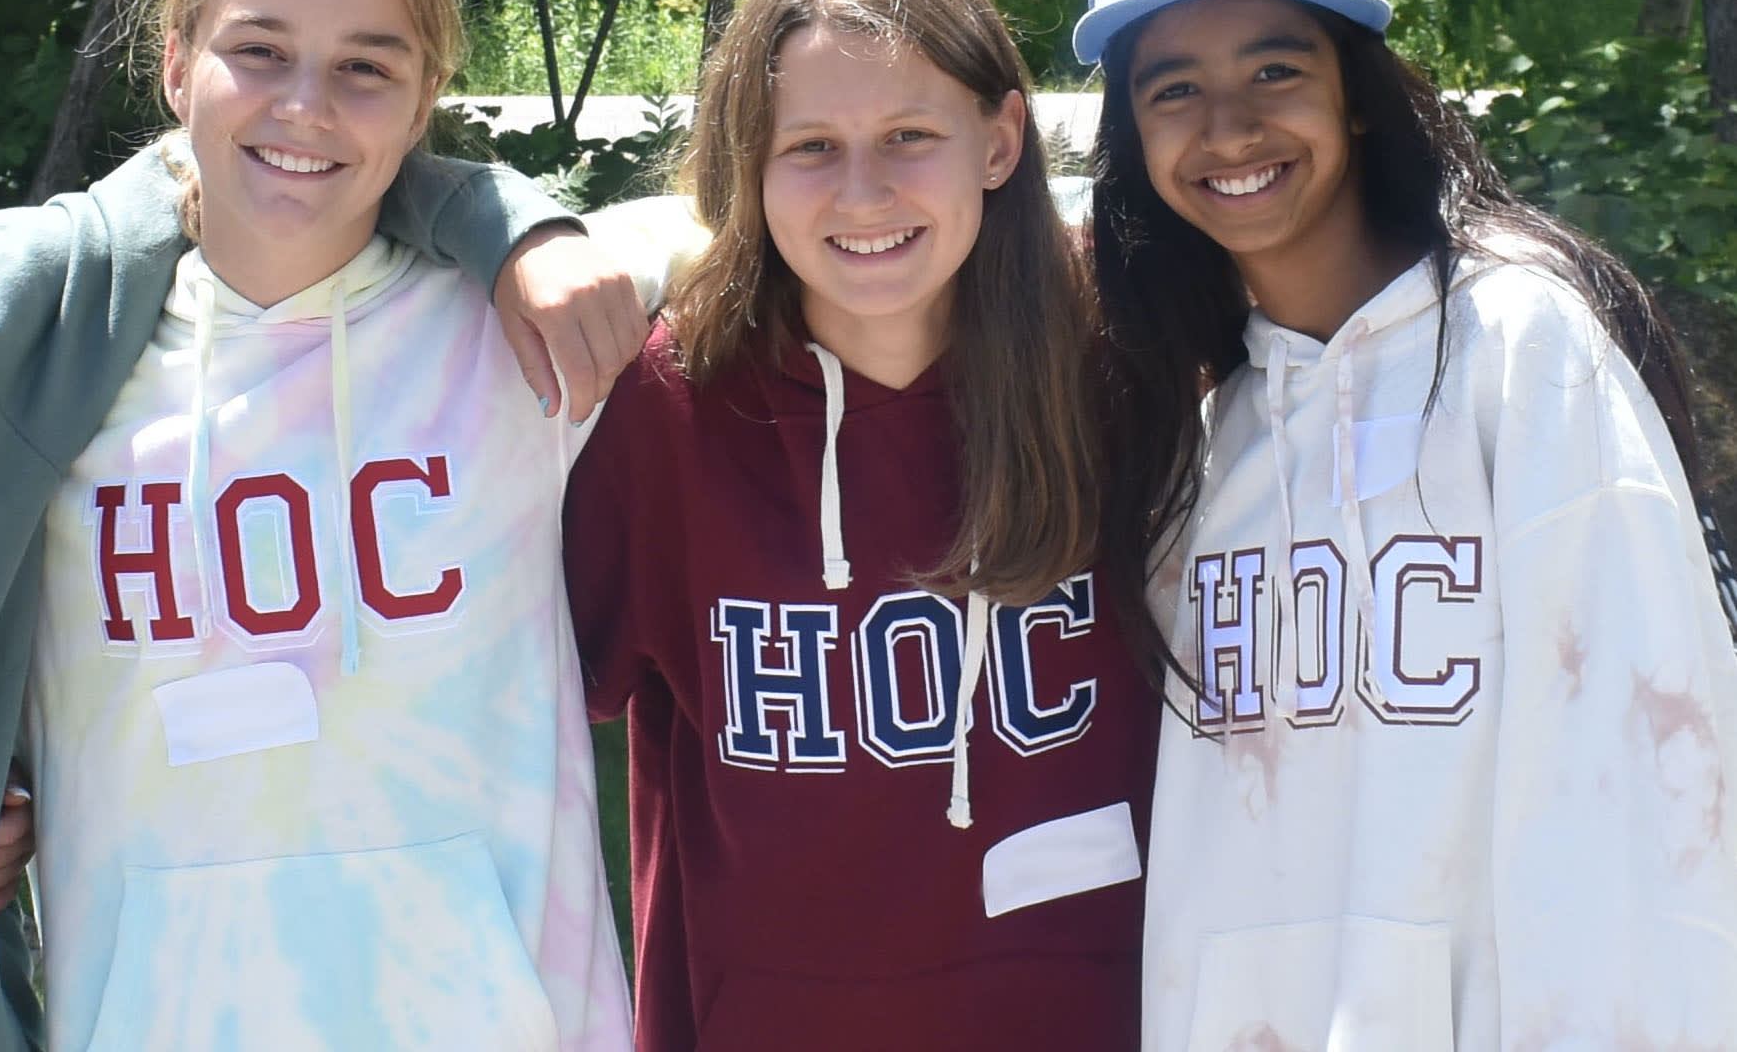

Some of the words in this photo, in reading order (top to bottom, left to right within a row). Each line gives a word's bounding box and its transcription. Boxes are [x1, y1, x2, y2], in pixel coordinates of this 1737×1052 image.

[84, 451, 466, 658] HOC
[1188, 534, 1483, 739] HOC
[710, 571, 1098, 774] HOC
